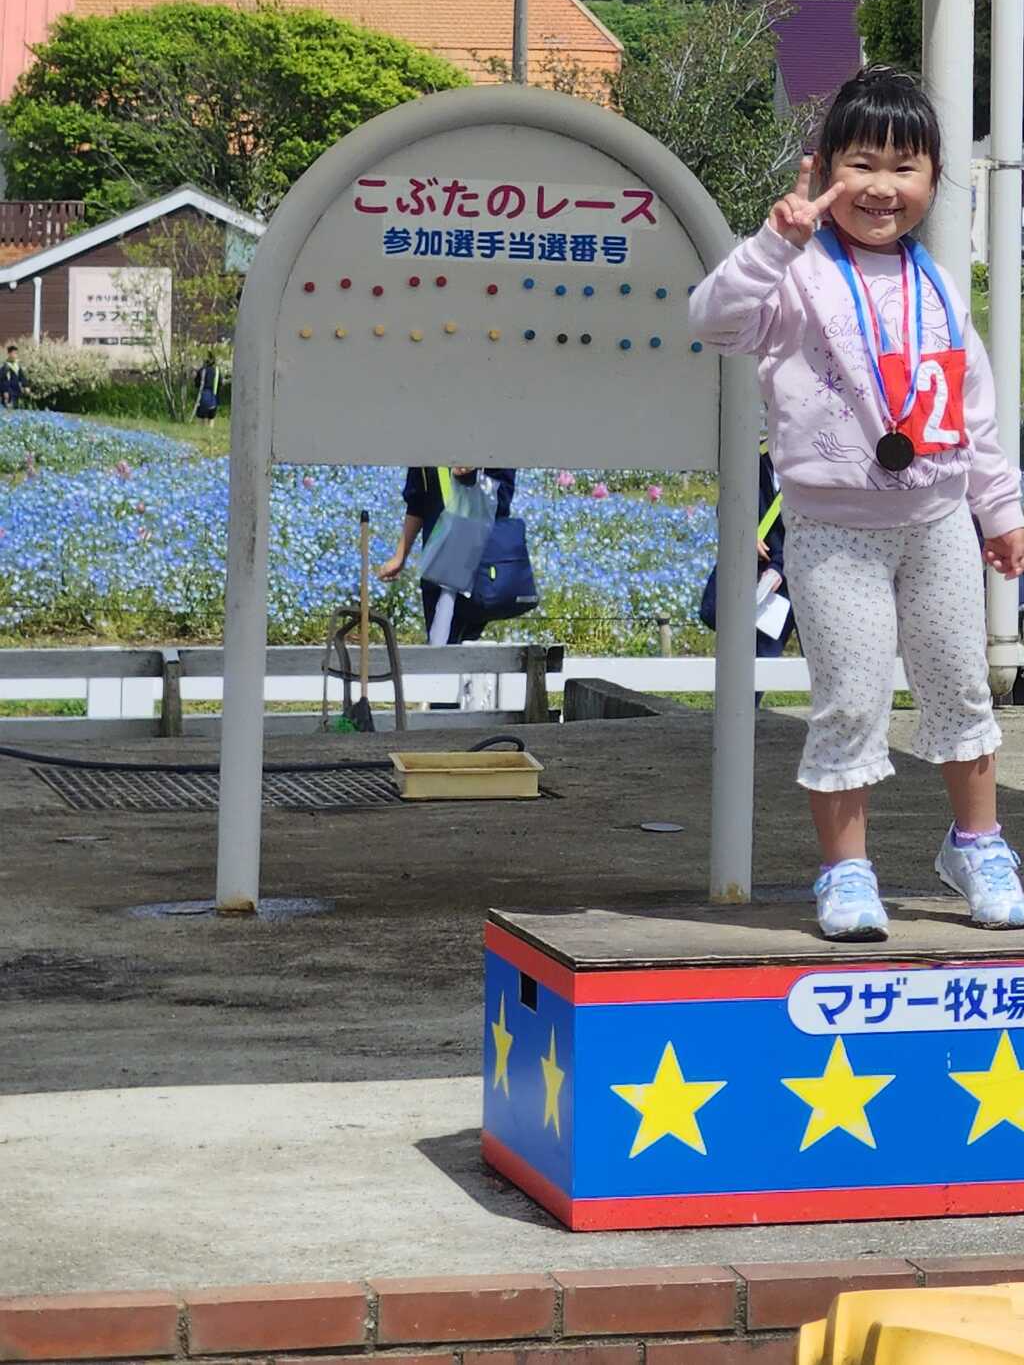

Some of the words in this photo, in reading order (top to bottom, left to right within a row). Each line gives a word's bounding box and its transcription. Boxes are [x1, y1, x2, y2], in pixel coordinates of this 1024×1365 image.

[354, 177, 657, 225] こぶたのレース
[383, 226, 629, 265] 参加選手当選番号
[916, 359, 960, 445] 2
